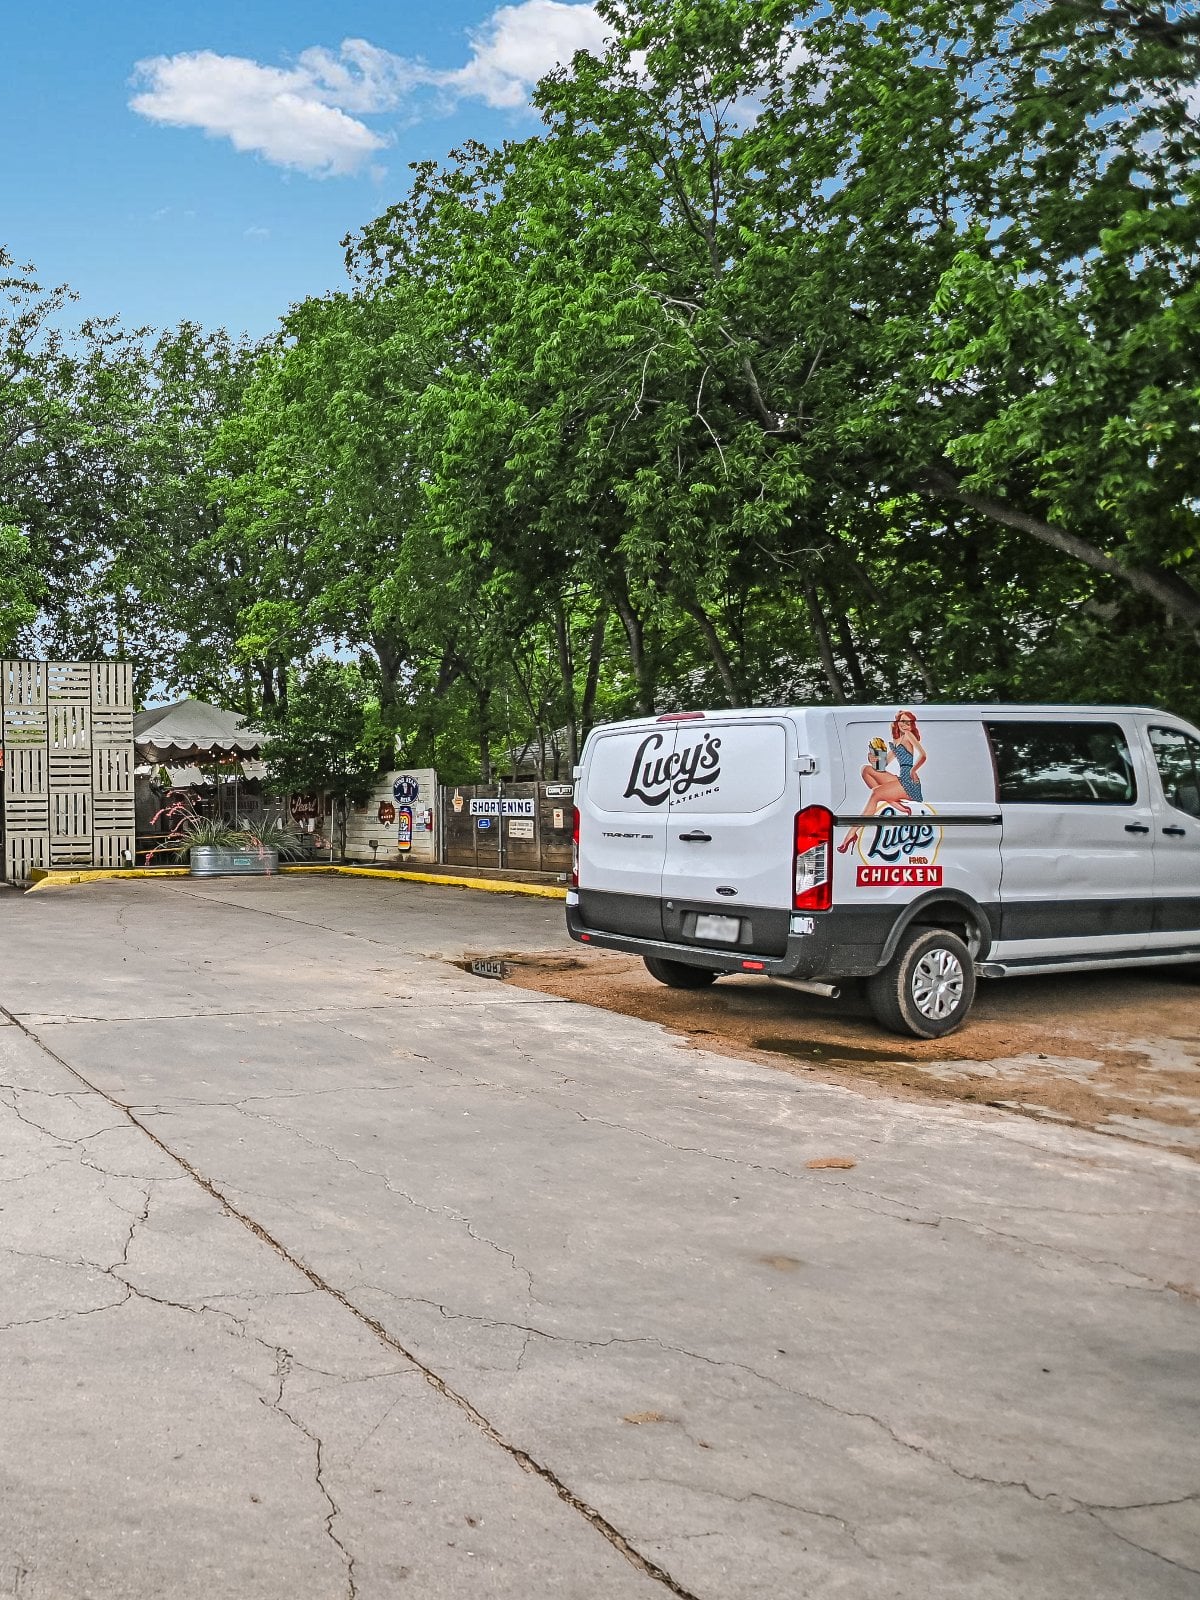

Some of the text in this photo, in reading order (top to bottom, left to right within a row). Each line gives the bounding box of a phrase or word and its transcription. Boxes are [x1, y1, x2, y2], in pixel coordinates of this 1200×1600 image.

[623, 733, 721, 806] Lucy's
[291, 796, 317, 814] Pearl
[670, 787, 720, 806] CATERING
[472, 801, 531, 813] SHORTENING
[868, 807, 934, 863] Lucy's
[908, 856, 928, 864] FRIED
[860, 868, 938, 882] CHICKEN
